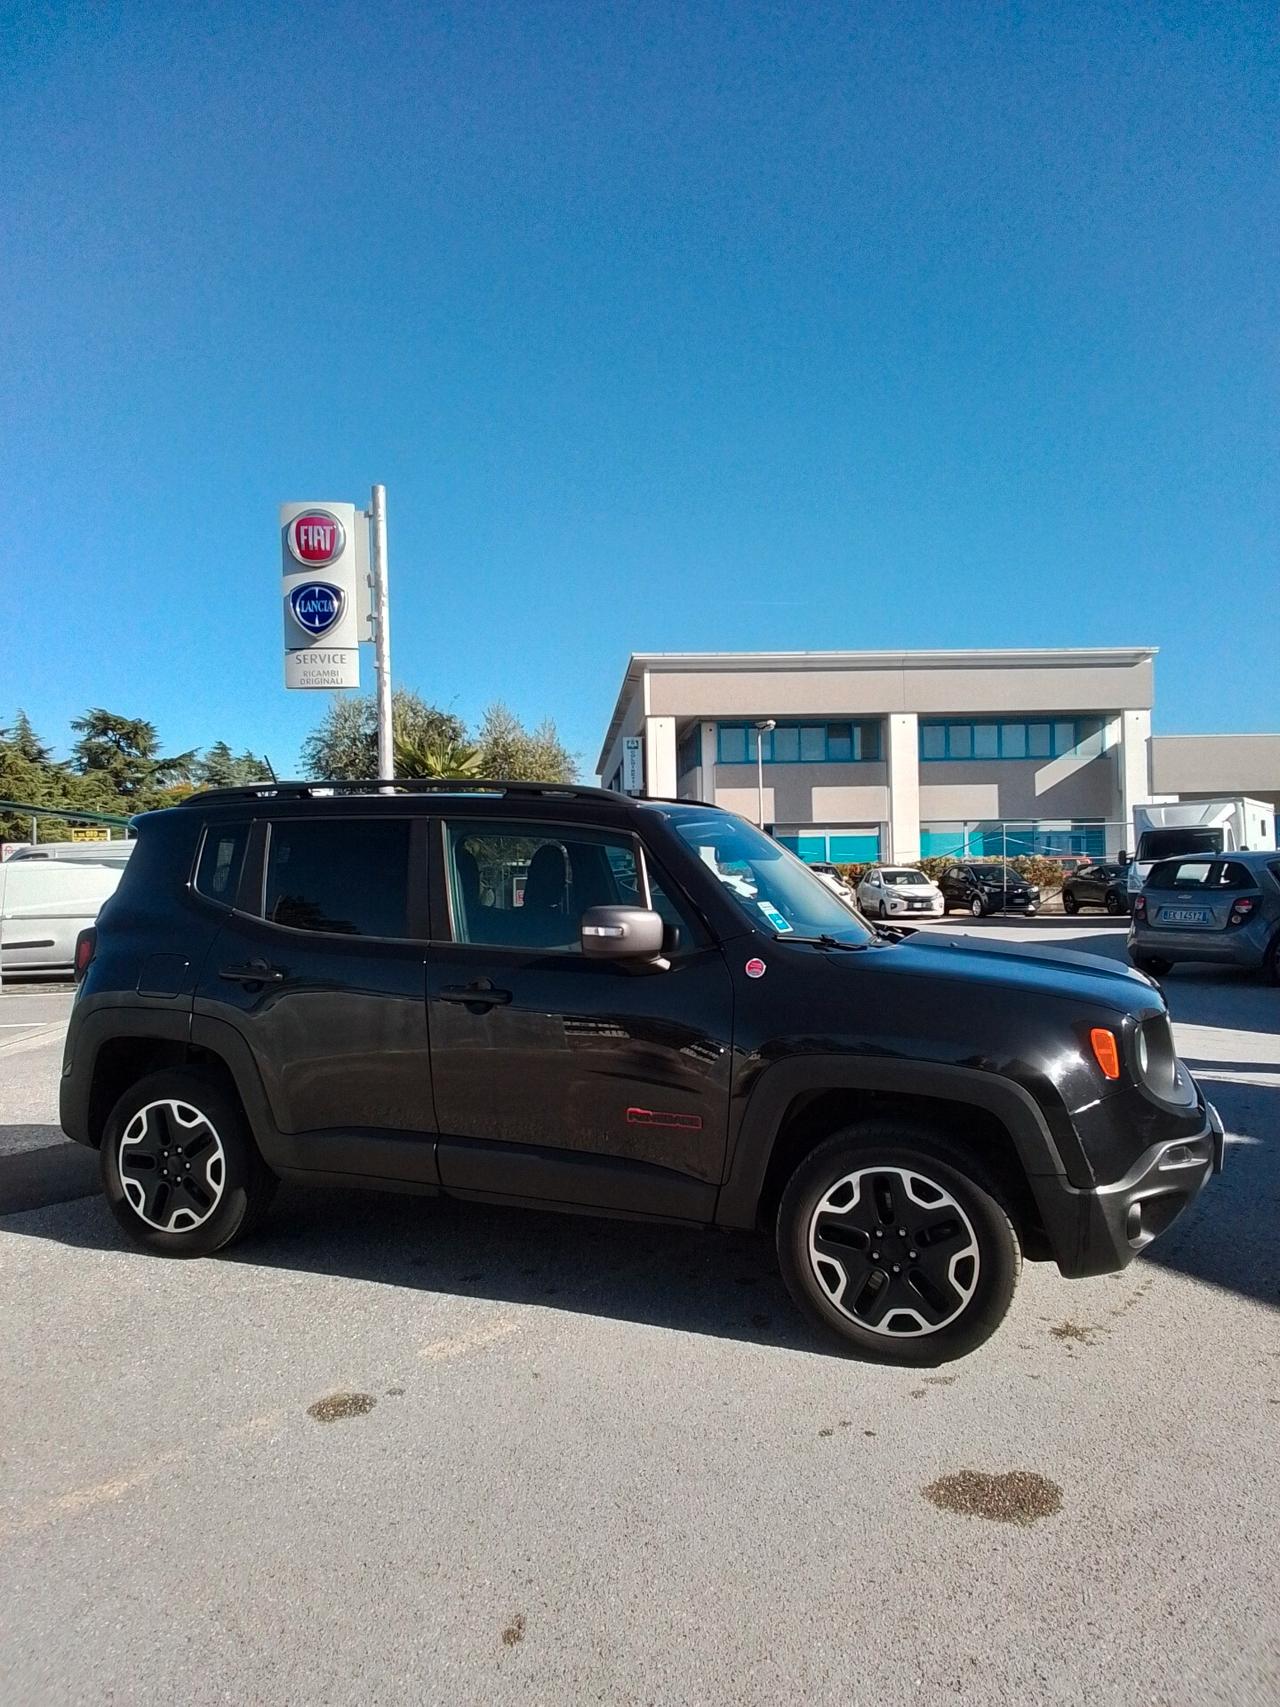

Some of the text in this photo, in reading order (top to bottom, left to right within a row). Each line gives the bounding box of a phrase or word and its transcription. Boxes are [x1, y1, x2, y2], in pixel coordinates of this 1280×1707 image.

[300, 525, 332, 551] FIAT
[301, 599, 334, 613] LANCIA
[295, 653, 347, 665] SERVICE
[303, 669, 340, 678] RICAMBI
[300, 677, 343, 685] ORIGINALI
